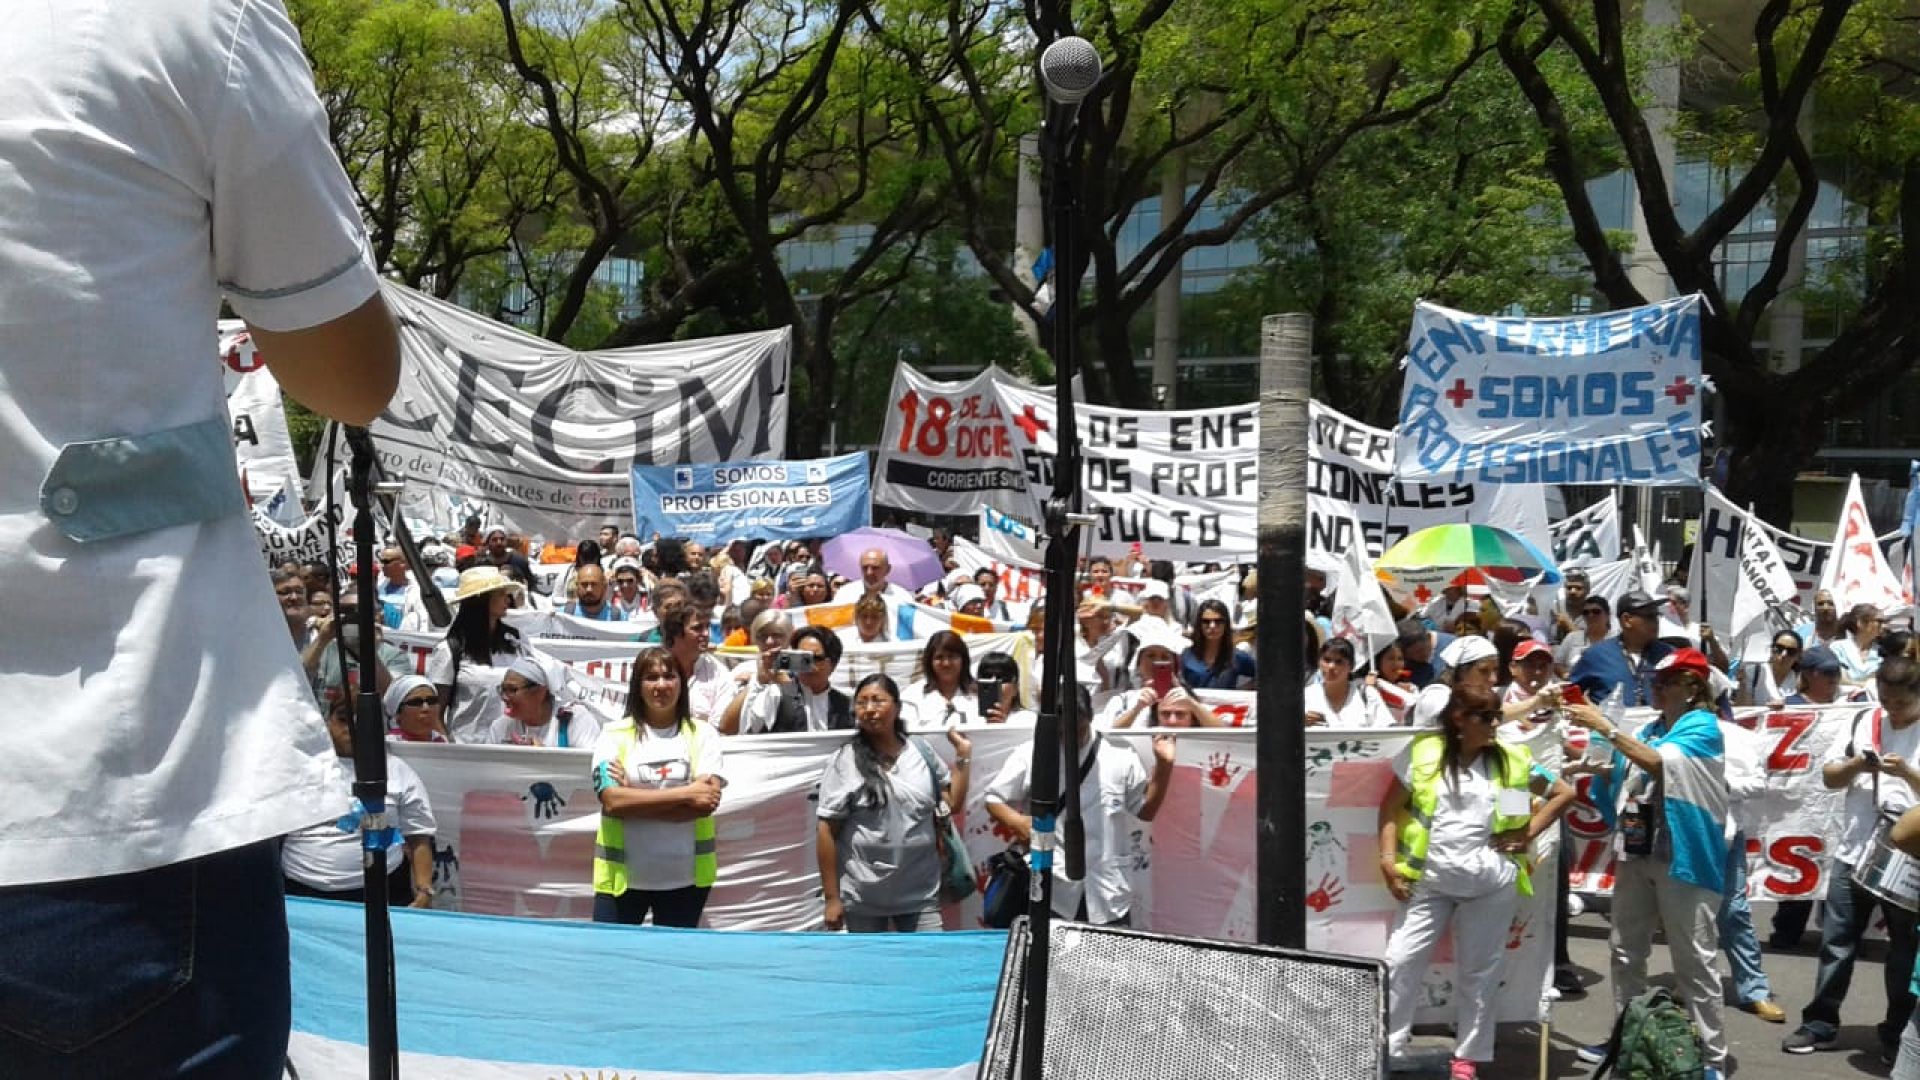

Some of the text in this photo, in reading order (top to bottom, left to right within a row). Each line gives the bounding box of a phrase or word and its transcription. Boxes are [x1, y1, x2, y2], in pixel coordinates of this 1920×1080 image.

[1409, 306, 1702, 382] ENFERMERIA
[1477, 371, 1655, 418] SOMOS
[898, 389, 951, 457] 18
[1079, 414, 1138, 449] OS
[408, 454, 433, 477] de
[550, 488, 574, 507] de
[715, 466, 786, 484] SOMOS
[662, 487, 830, 511] PROFESIONALES
[1099, 507, 1220, 546] JULIO
